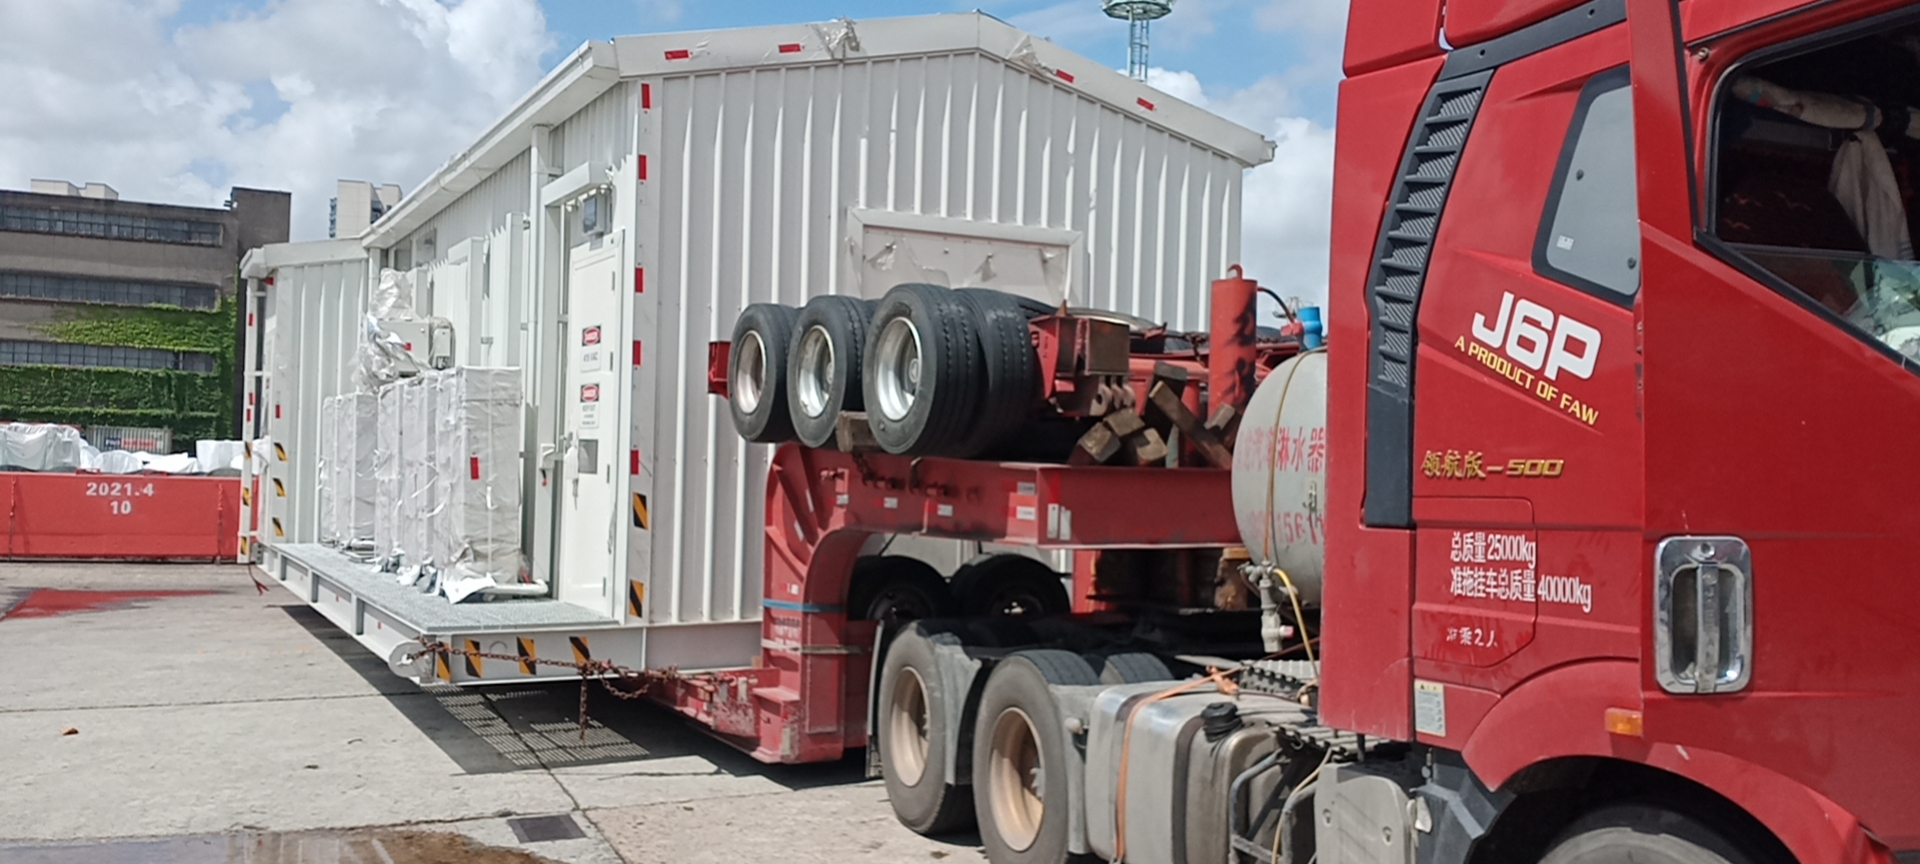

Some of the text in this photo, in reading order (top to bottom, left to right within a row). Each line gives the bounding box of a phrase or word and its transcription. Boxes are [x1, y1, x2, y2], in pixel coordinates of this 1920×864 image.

[1471, 291, 1601, 381] J6P
[1454, 335, 1599, 426] A PRODUCT OF FAW
[86, 482, 154, 497] 2021.4
[110, 500, 132, 515] 10
